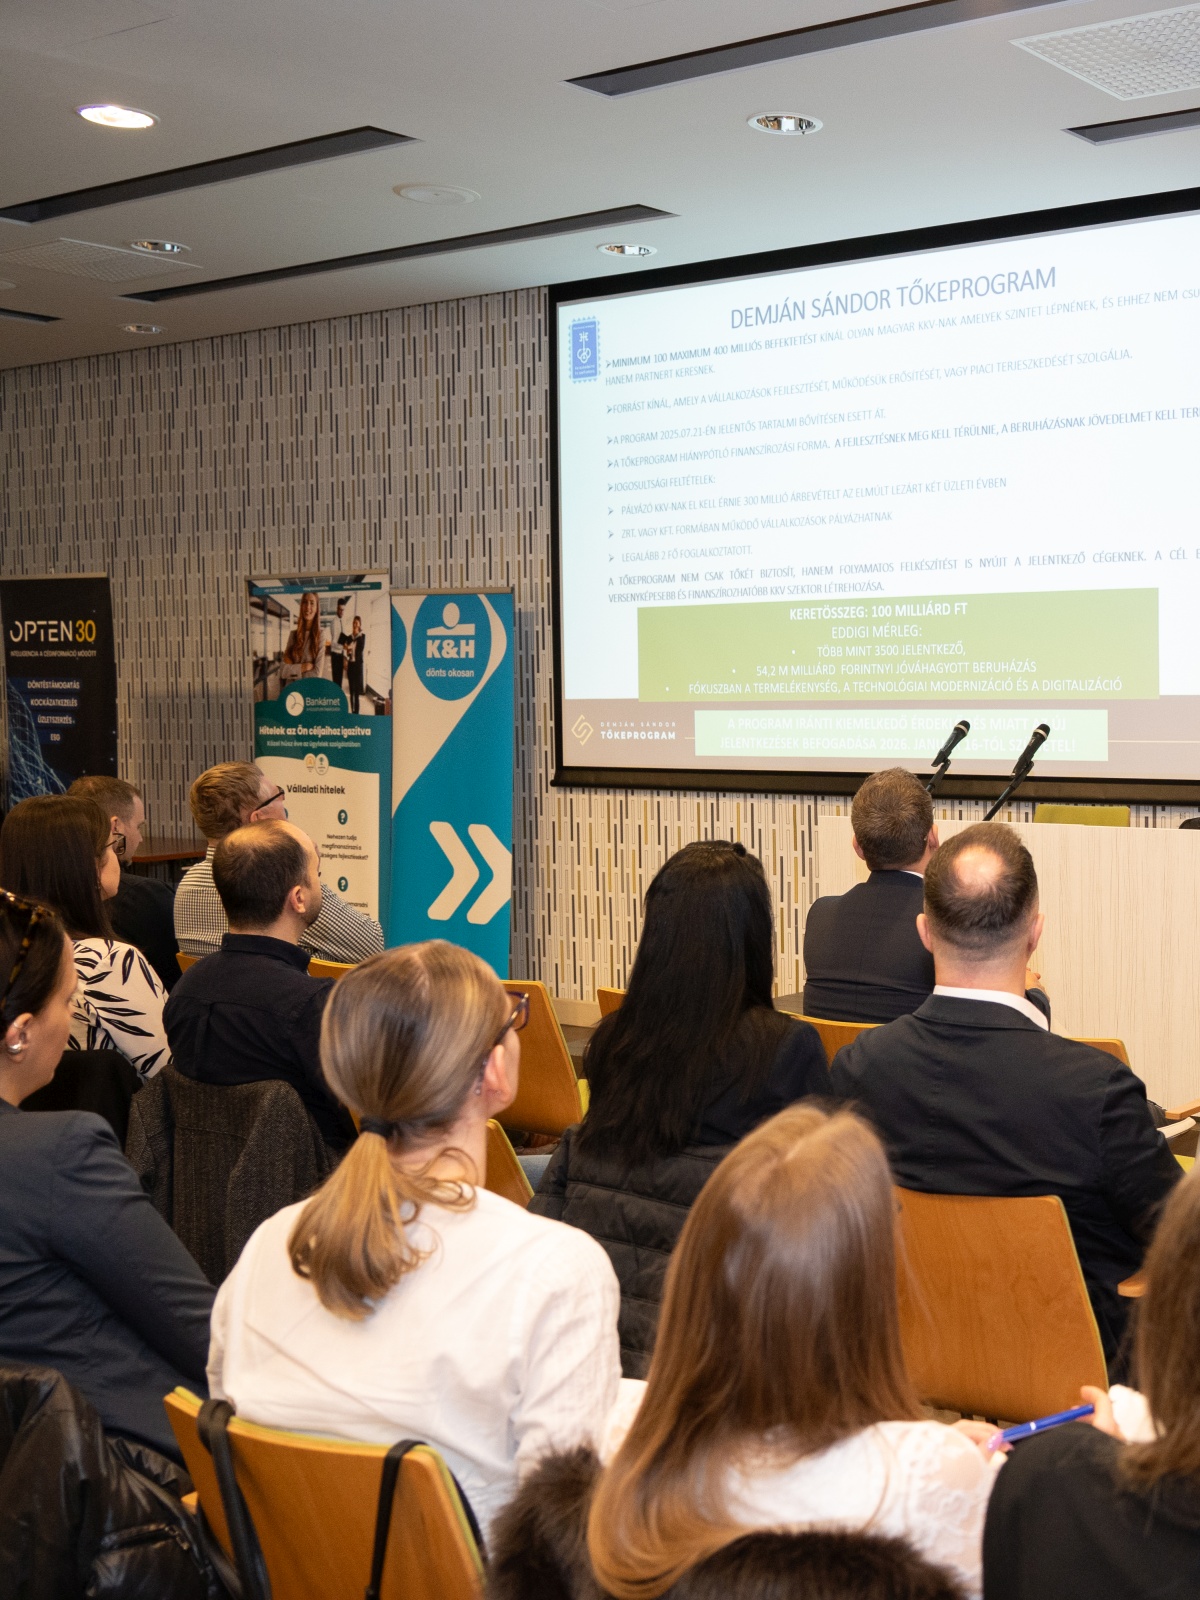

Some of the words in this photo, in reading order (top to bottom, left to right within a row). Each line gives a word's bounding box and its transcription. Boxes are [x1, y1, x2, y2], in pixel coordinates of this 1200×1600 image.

[731, 297, 805, 329] DEMJÁN
[811, 288, 891, 319] SÁNDOR
[896, 267, 1056, 308] TŐKEPROGRAM
[611, 354, 650, 368] MINIMUM
[654, 352, 667, 363] 100
[669, 347, 711, 361] MAXIMUM
[713, 345, 728, 356] 400
[730, 339, 761, 354] MILLIÓS
[764, 333, 816, 350] BEFEKTETÉST
[820, 329, 843, 343] KÍNÁL
[847, 327, 874, 340] OLYAN
[877, 322, 914, 337] MAGYAR
[918, 317, 957, 332] KKV-NAK
[960, 311, 1001, 327] AMELYEK
[1005, 307, 1041, 321] SZINTET
[1046, 300, 1098, 317] LÉPNÉNEK,
[1102, 296, 1113, 310] ÉS
[1117, 293, 1150, 308] EHHEZ
[1153, 290, 1178, 304] NEM
[605, 374, 632, 387] HANEM
[635, 369, 672, 383] PARTNERT
[675, 364, 715, 378] KERESNEK.
[613, 434, 619, 445] A
[620, 431, 658, 444] PROGRAM
[660, 424, 715, 440] 2025.07.21-ÉN
[718, 420, 756, 435] JELENTŐS
[758, 417, 797, 431] TARTALMI
[799, 412, 844, 427] BŐVÍTÉSEN
[847, 410, 872, 422] ESETT
[874, 408, 886, 420] ÁT.
[613, 458, 619, 468] A
[620, 453, 677, 467] TŐKEPROGRAM
[679, 446, 729, 462] HIÁNYPÓTLÓ
[730, 441, 794, 458] FINANSZÍROZÁSI
[797, 440, 830, 452] FORMA.
[834, 439, 841, 449] A
[842, 432, 906, 448] FEJLESZTÉSNEK
[907, 431, 929, 443] MEG
[930, 429, 949, 441] KELL
[954, 425, 999, 439] TÉRÜLNIE,
[1000, 424, 1008, 435] A
[1010, 417, 1085, 434] BERUHÁZÁSNAK
[1088, 411, 1151, 428] JÖVEDELMET
[1154, 409, 1178, 422] KELL
[613, 477, 668, 493] JOGOSULTSÁGI
[669, 474, 715, 488] FELTÉTELEK:
[607, 576, 614, 586] A
[619, 573, 675, 585] TŐKEPROGRAM
[680, 572, 699, 583] NEM
[704, 571, 724, 582] CSAK
[730, 568, 753, 581] TŐKÉT
[760, 566, 796, 580] BIZTOSÍT,
[801, 566, 833, 578] HANEM
[839, 563, 894, 576] FOLYAMATOS
[900, 559, 956, 573] FELKÉSZÍTÉST
[964, 560, 973, 570] IS
[979, 556, 1006, 570] NYÚJT
[1014, 557, 1022, 568] A
[1028, 552, 1086, 568] JELENTKEZŐ
[1092, 552, 1147, 565] CÉGEKNEK.
[1154, 551, 1162, 562] A
[1169, 548, 1187, 562] CÉL
[608, 589, 676, 603] VERSENYKÉPESEBB
[677, 588, 686, 600] ÉS
[770, 585, 785, 596] KKV
[786, 584, 822, 595] SZEKTOR
[824, 580, 885, 593] LÉTREHOZÁSA.
[789, 604, 868, 620] KERETÖSSZEG:
[871, 605, 892, 617] 100
[895, 601, 951, 617] MILLIÁRD
[954, 603, 968, 615] FT
[831, 626, 869, 639] EDDIGI
[872, 623, 922, 638] MÉRLEG:
[426, 639, 475, 659] K&H
[816, 644, 843, 657] TÖBB
[845, 645, 872, 657] MINT
[874, 645, 899, 656] 3500
[901, 642, 966, 657] JELENTKEZŐ,
[426, 668, 447, 677] dönts
[448, 668, 474, 677] okosan
[756, 665, 776, 678] 54,2
[778, 665, 788, 676] M
[790, 662, 836, 676] MILLIÁRD
[841, 664, 893, 675] FORINTNYI
[895, 661, 969, 675] JÓVÁHAGYOTT
[972, 660, 1037, 674] BERUHÁZÁS
[27, 680, 80, 689] DÖNTÉSTÁMOGATÁS
[688, 681, 742, 694] FÓKUSZBAN
[744, 683, 751, 694] A
[753, 680, 841, 695] TERMELÉKENYSÉG,
[843, 682, 850, 693] A
[852, 680, 927, 693] TECHNOLÓGIAI
[930, 679, 1013, 692] MODERNIZÁCIÓ
[1016, 679, 1028, 692] ÉS
[1031, 681, 1039, 692] A
[1042, 678, 1122, 691] DIGITALIZÁCIÓ
[30, 698, 78, 707] KOCKÁZATKEZELÉS
[305, 697, 340, 706] Bankárnet
[259, 726, 285, 736] Hitelek
[297, 724, 308, 735] Ön
[309, 725, 341, 738] céljaihoz
[341, 725, 371, 738] igazítva
[600, 730, 676, 740] TŐKEPROGRAM
[286, 784, 319, 794] Vállalati
[319, 785, 345, 795] hitelek
